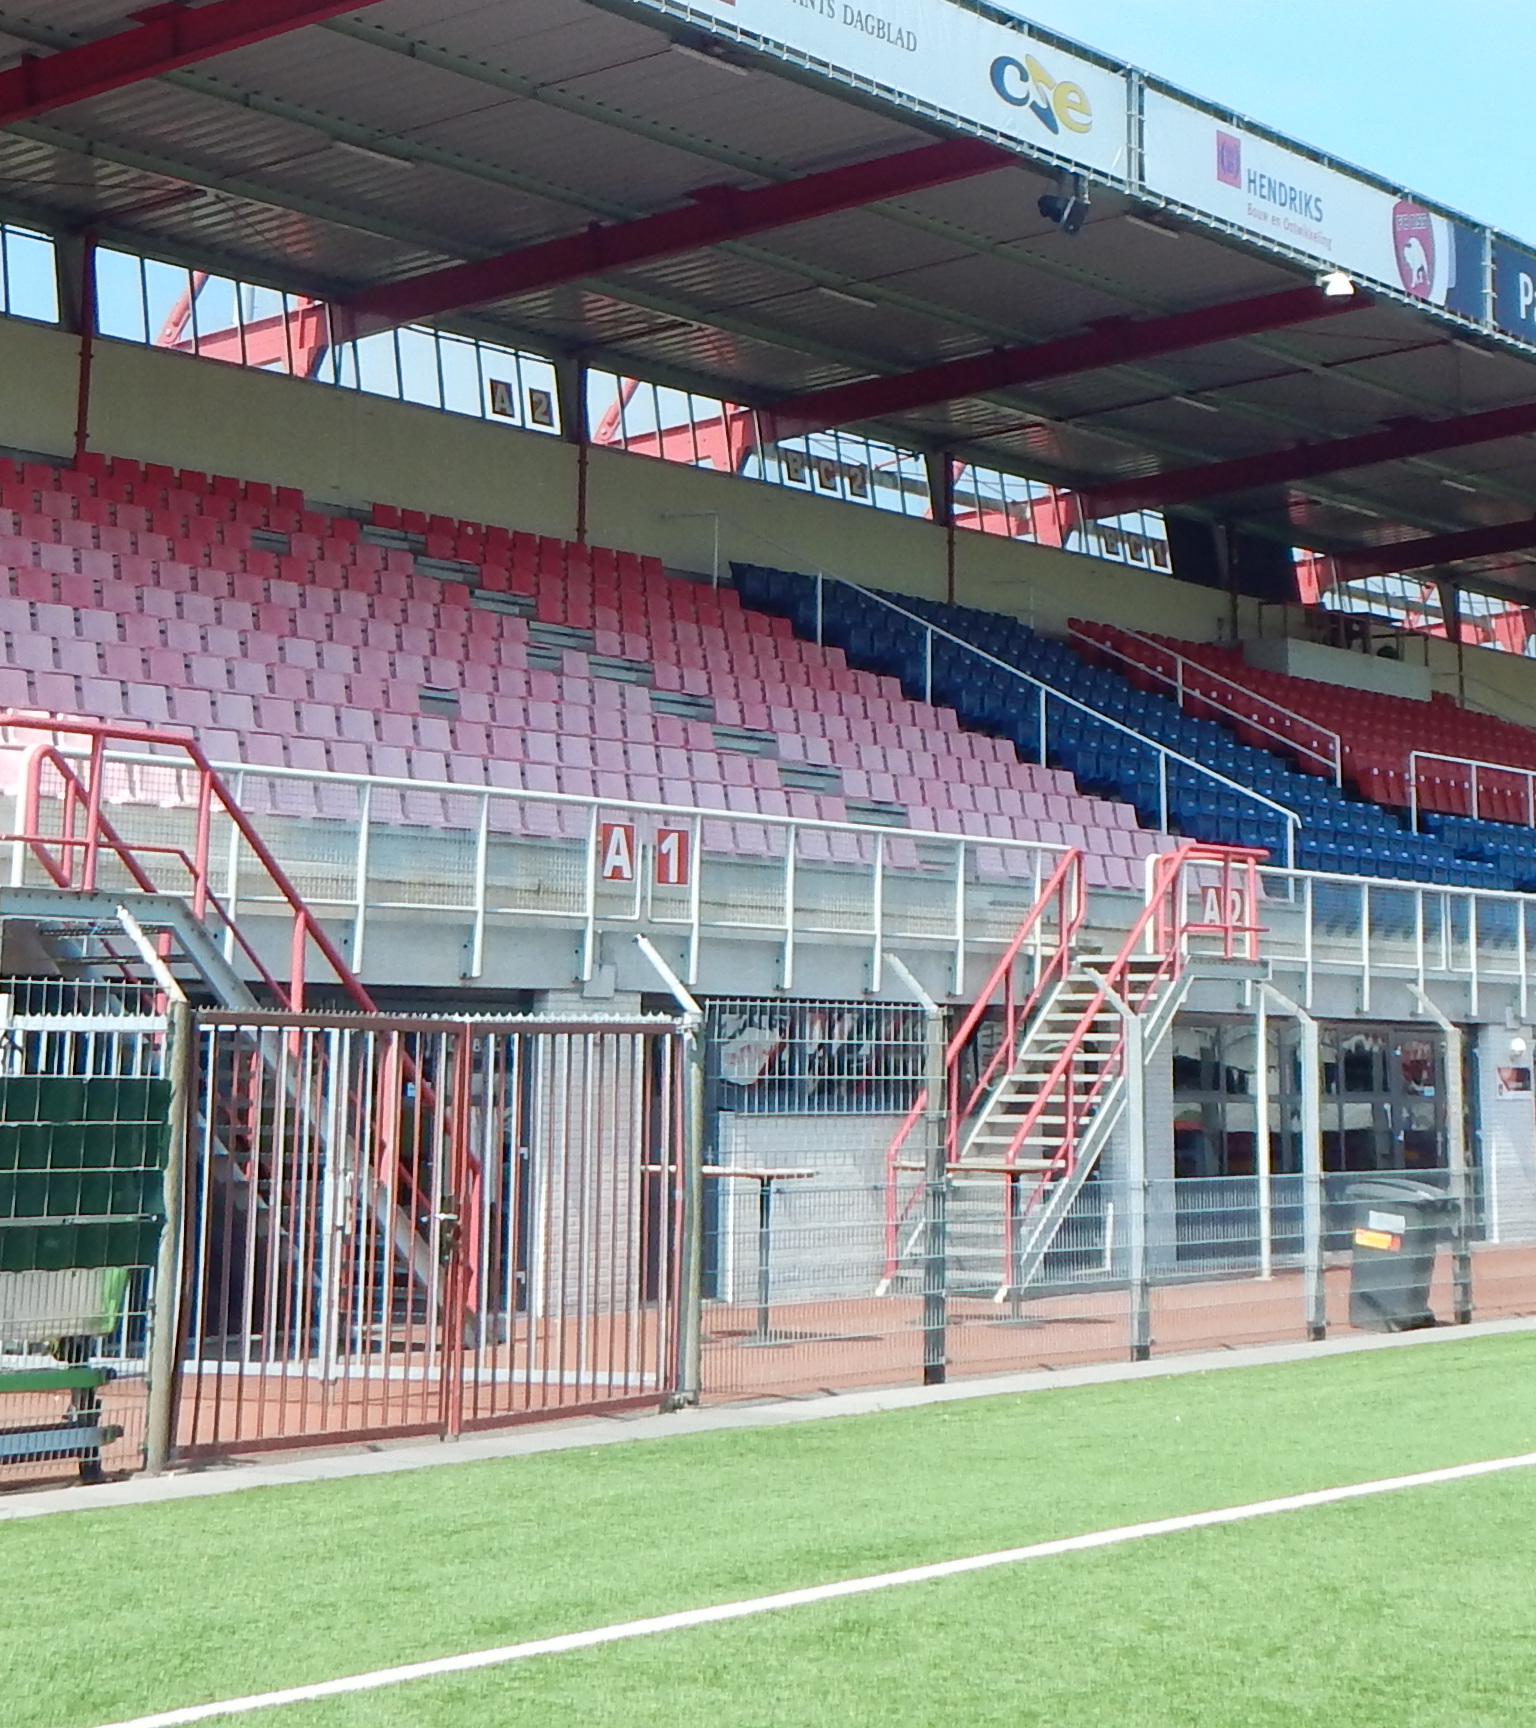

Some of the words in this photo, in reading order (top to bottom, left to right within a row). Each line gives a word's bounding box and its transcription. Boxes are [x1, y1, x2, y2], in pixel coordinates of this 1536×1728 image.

[842, 4, 918, 52] DAGBLAD
[1247, 168, 1324, 223] HENDRIKS
[494, 383, 515, 416] A
[532, 392, 550, 423] 2
[602, 826, 633, 879] A
[660, 832, 680, 883] 1
[1203, 887, 1221, 926] A
